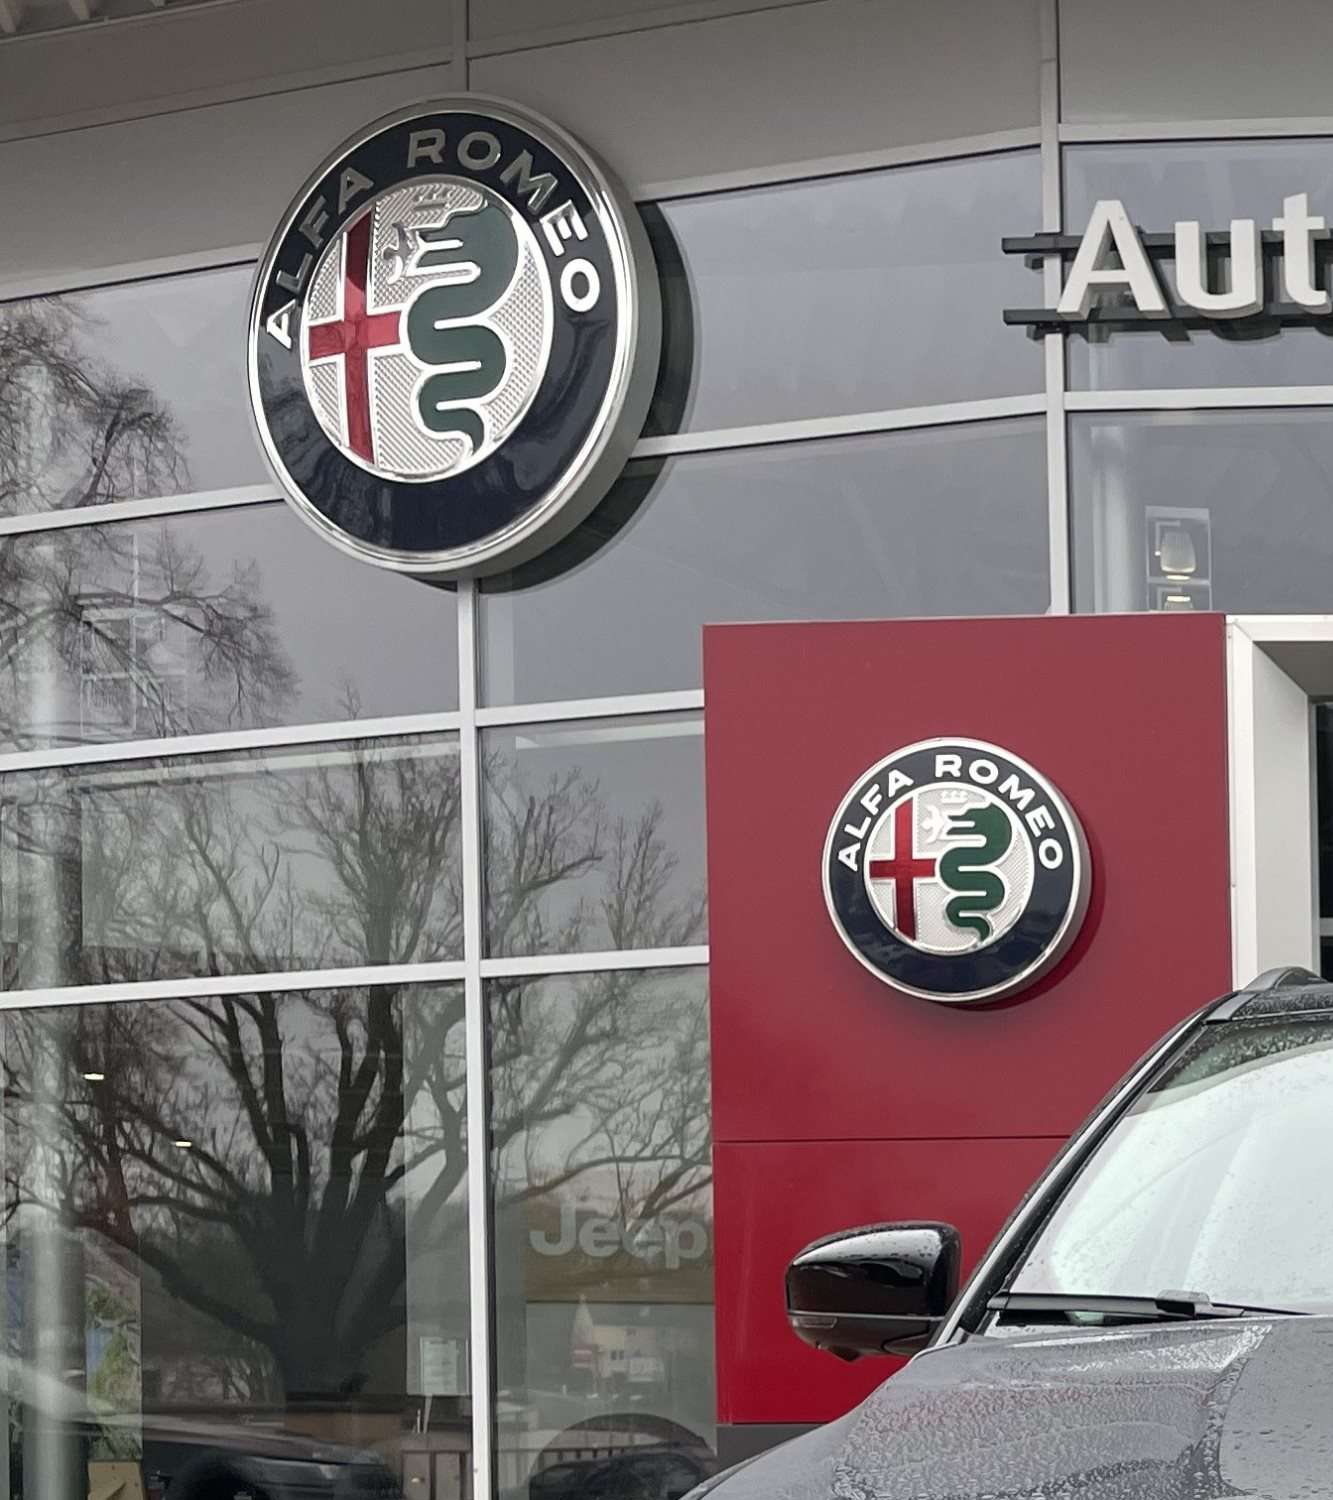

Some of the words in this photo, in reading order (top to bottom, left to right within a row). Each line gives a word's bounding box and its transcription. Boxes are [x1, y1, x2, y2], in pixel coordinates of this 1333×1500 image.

[266, 166, 374, 349] ALFA
[406, 127, 601, 312] ROMEO
[838, 769, 914, 872] ALFA
[935, 754, 1063, 870] ROMEO
[529, 1198, 708, 1270] Jeep
